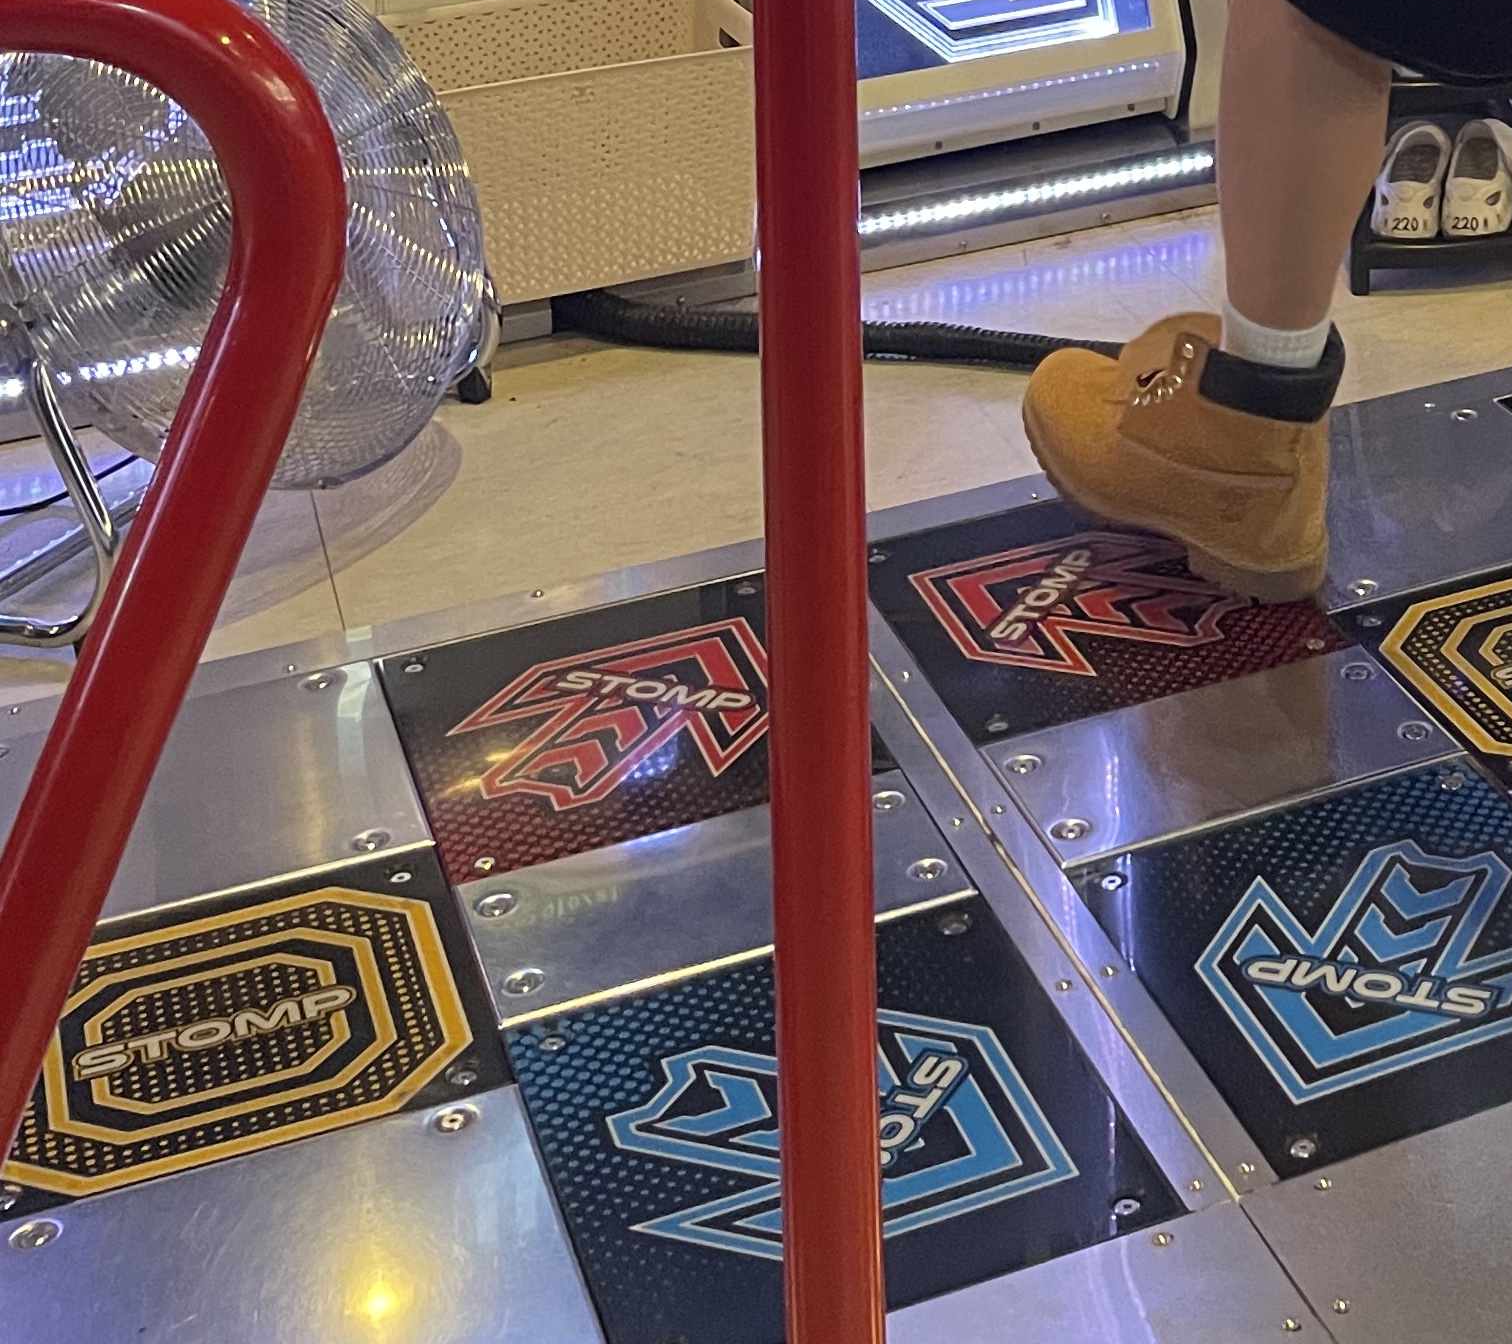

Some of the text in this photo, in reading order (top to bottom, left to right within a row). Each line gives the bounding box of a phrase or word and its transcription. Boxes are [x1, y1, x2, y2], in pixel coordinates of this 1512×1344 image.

[1391, 216, 1420, 232] 220
[1451, 215, 1480, 232] 220
[987, 545, 1098, 645] STOMP
[557, 666, 761, 715] STOMP
[1243, 950, 1499, 1020] STOMP
[73, 983, 356, 1082] STOMP
[880, 1050, 965, 1166] STO
